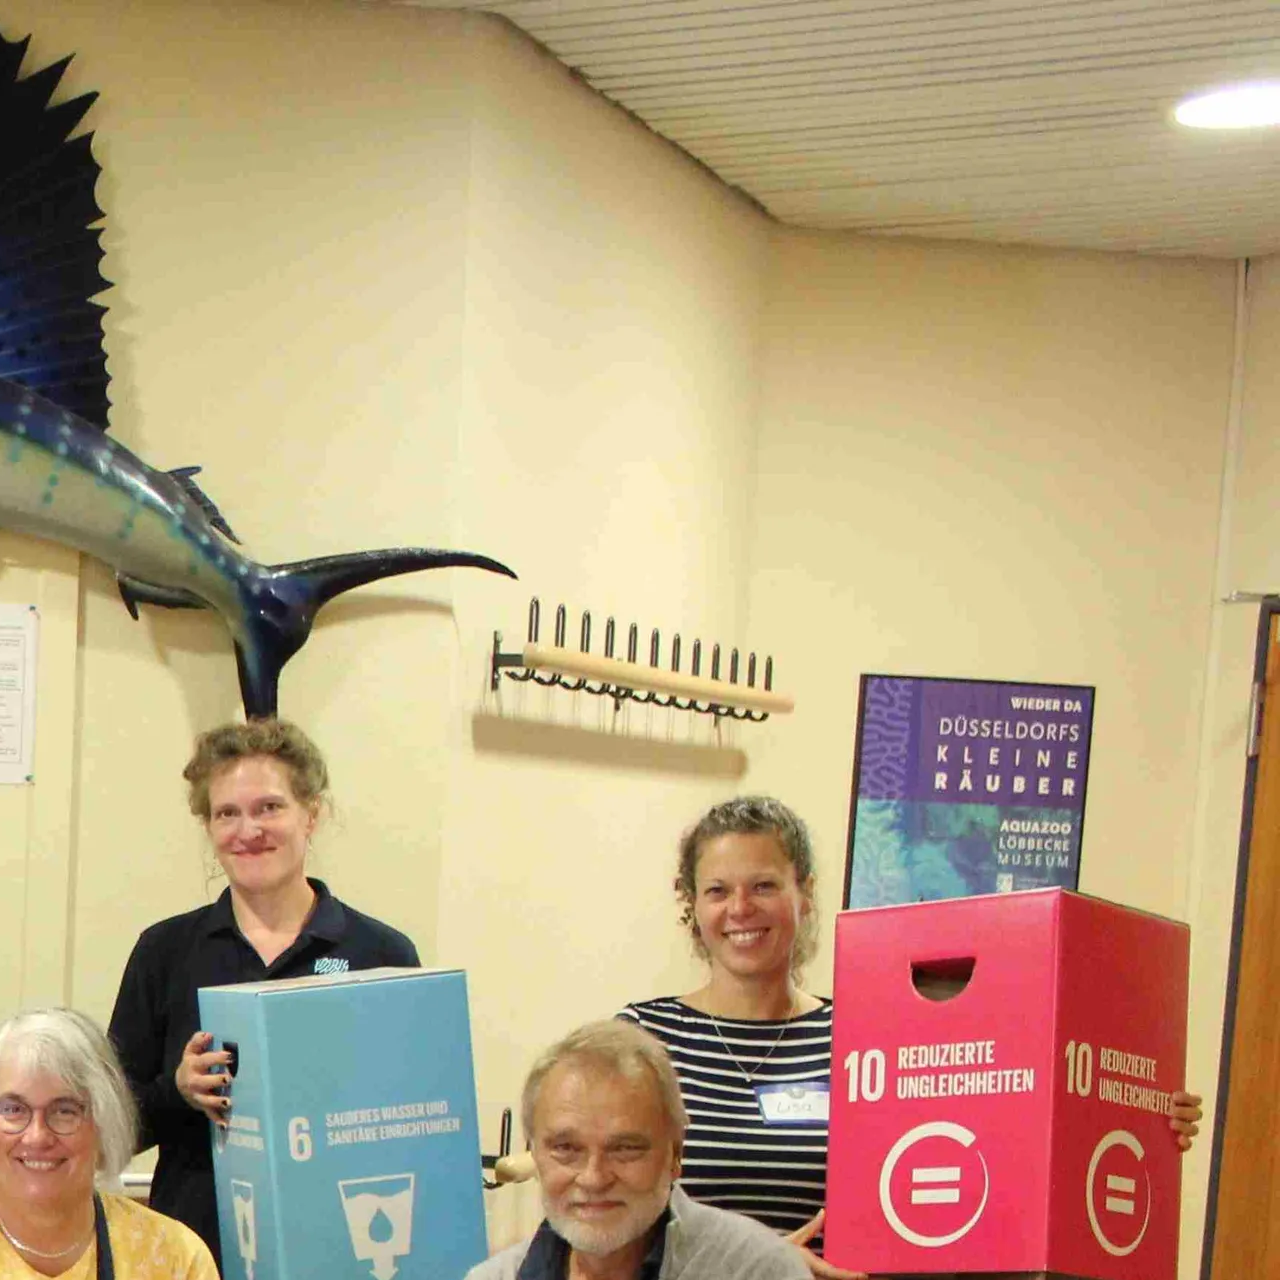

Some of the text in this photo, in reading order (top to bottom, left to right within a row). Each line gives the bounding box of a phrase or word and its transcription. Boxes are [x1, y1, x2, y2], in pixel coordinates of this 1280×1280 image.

[1011, 697, 1082, 713] WIEDER DA
[939, 715, 1080, 742] DÜSSELDORFS
[936, 745, 1078, 769] KLEINE
[934, 769, 1076, 796] RÄUBER
[1001, 820, 1072, 835] AQUAZOO
[999, 835, 1069, 852] LÖBBECKE
[997, 852, 1069, 868] MUSEUM
[844, 1040, 995, 1103] 10 REDUZIERTE
[1064, 1040, 1157, 1098] 10 REDUZIERTE
[897, 1068, 1035, 1100] UNGLEICHHEITEN
[288, 1101, 448, 1162] 6 SAUBERES WASSER UND
[327, 1117, 460, 1146] SANITÄRE EINRICHTUNGEN
